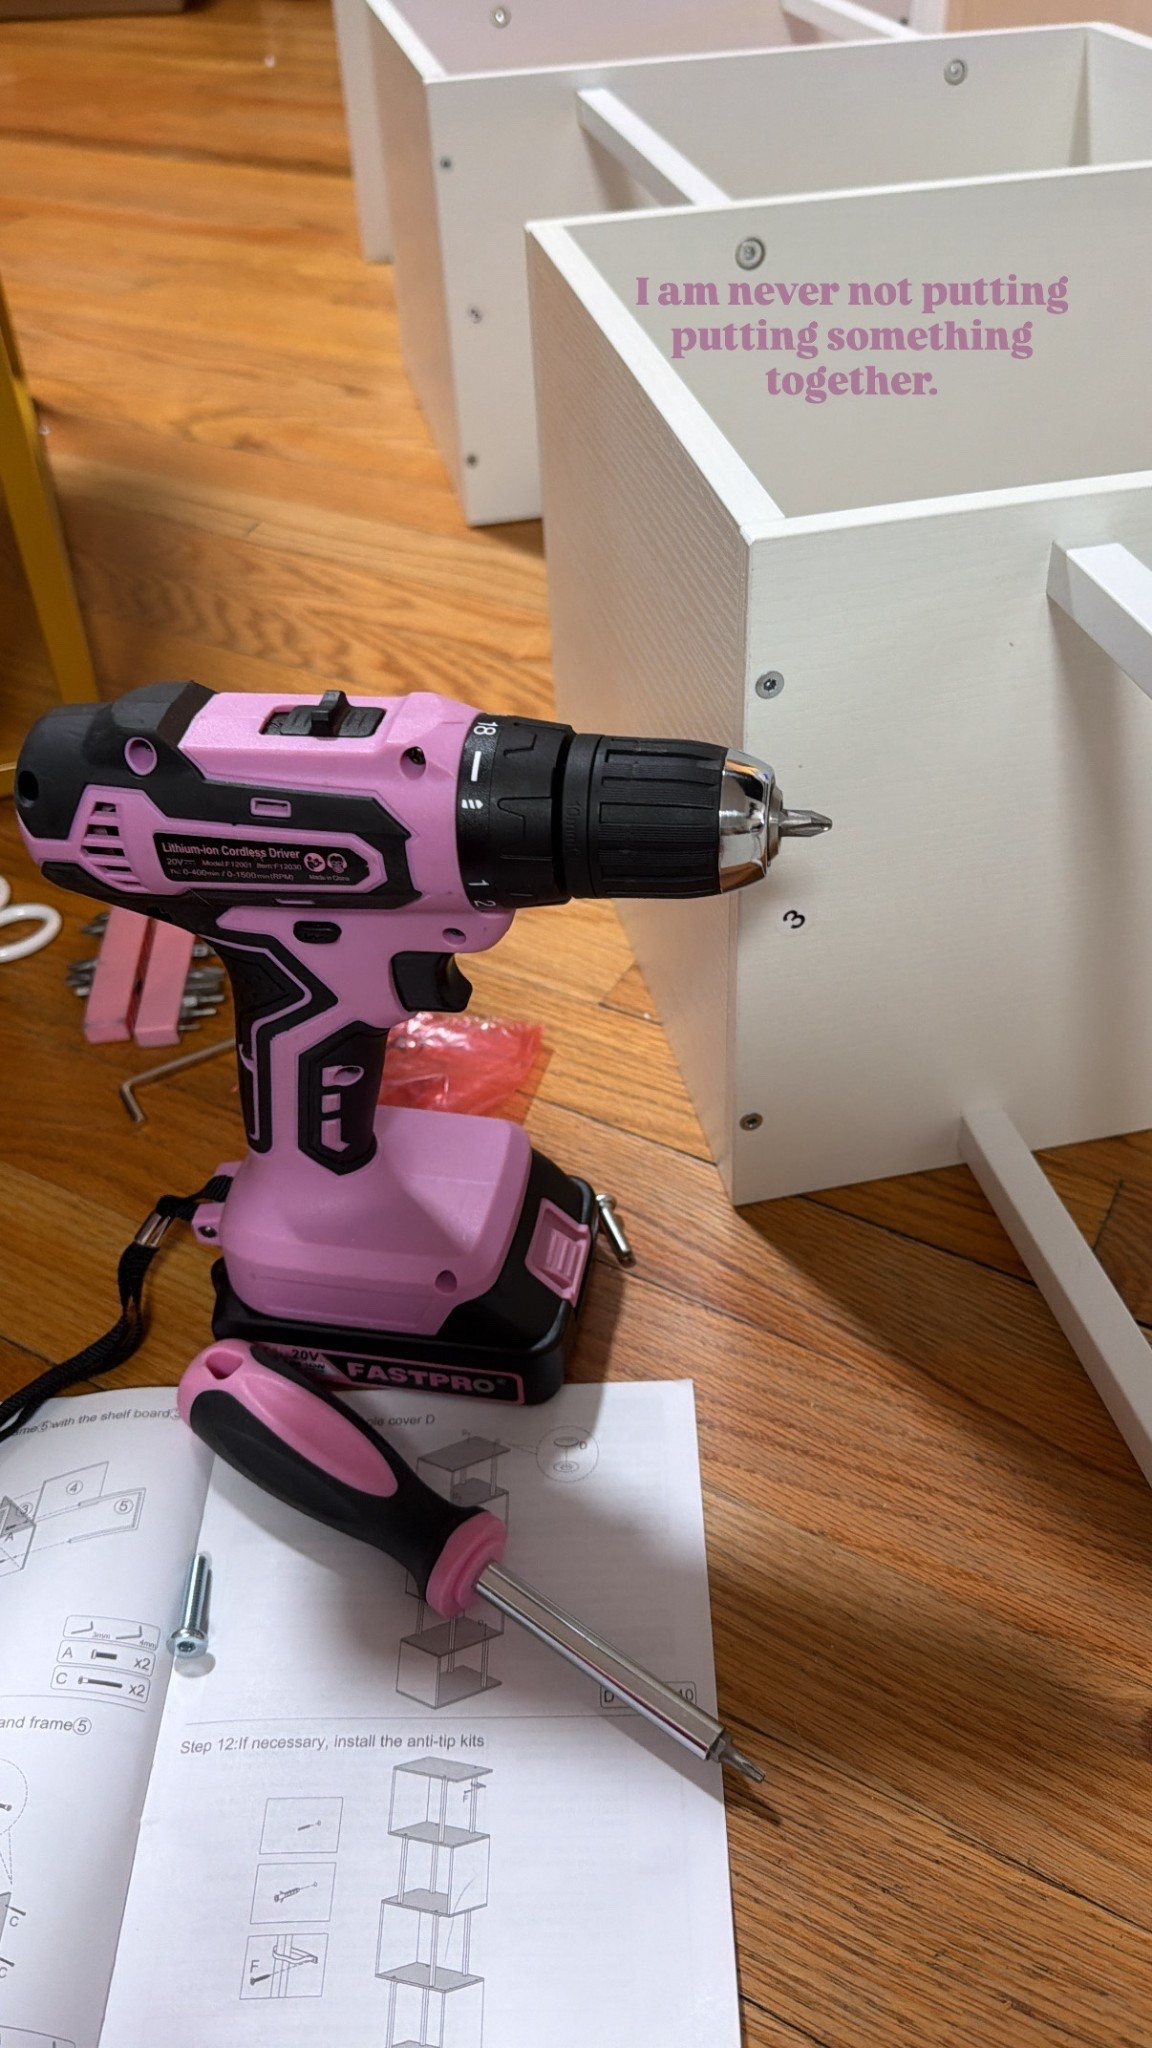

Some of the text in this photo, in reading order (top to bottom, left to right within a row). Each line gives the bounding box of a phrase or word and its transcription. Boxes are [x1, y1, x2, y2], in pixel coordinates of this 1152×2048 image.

[473, 721, 499, 736] 18
[161, 842, 301, 860] Lithium-ion Cordless Driver
[782, 909, 806, 930] 3
[291, 1348, 319, 1362] 20V
[346, 1362, 496, 1394] FASTPRO
[51, 1417, 75, 1430] with
[78, 1413, 97, 1425] the
[100, 1408, 131, 1422] shelf
[387, 1416, 422, 1427] cover
[425, 1413, 436, 1425] D
[61, 1646, 151, 1671] A x2
[55, 1671, 146, 1698] C x2
[0, 1716, 26, 1729] and
[180, 1741, 212, 1755] Step
[251, 1737, 329, 1752] necessary,
[334, 1734, 376, 1748] install
[380, 1734, 402, 1748] the
[407, 1734, 456, 1751] anti-tip
[460, 1734, 485, 1748] kits
[250, 1959, 260, 1973] F
